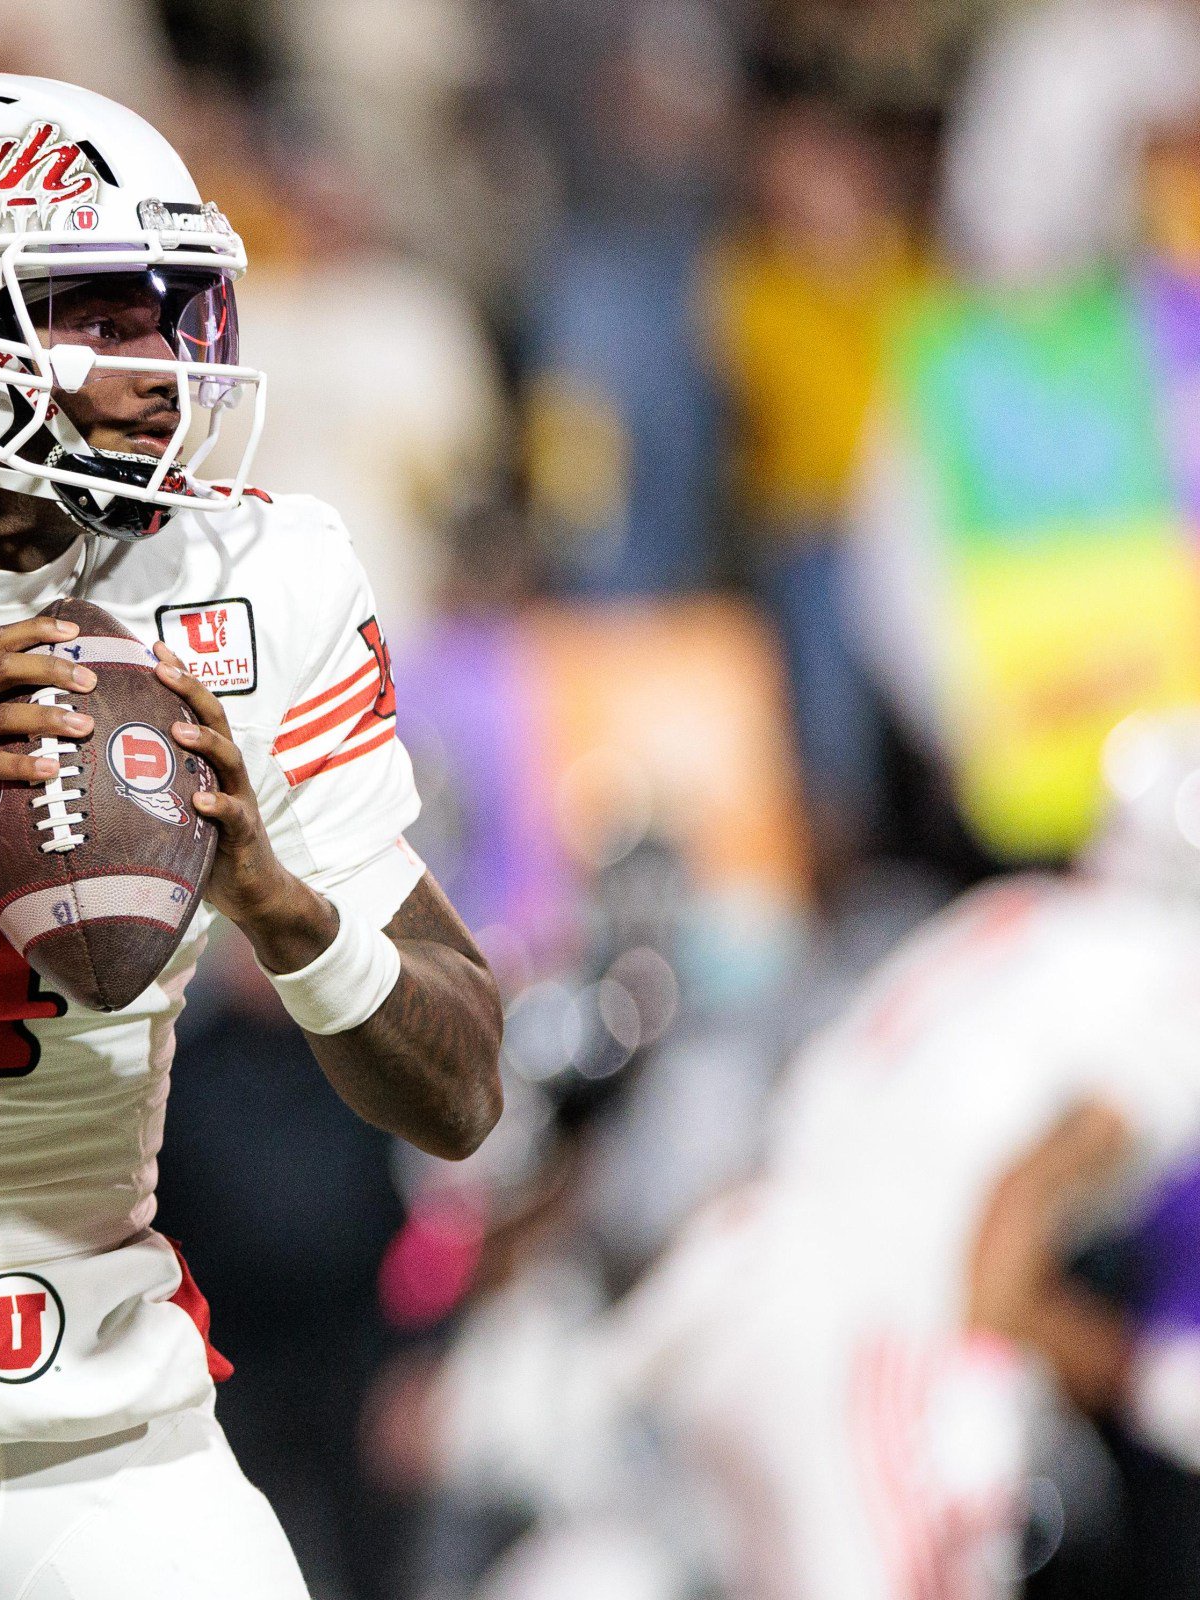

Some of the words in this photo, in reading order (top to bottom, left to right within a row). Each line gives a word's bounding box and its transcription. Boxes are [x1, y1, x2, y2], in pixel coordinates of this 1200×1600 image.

[76, 211, 94, 229] U
[189, 658, 248, 679] EALTH
[121, 734, 168, 780] U
[193, 772, 208, 840] TEM
